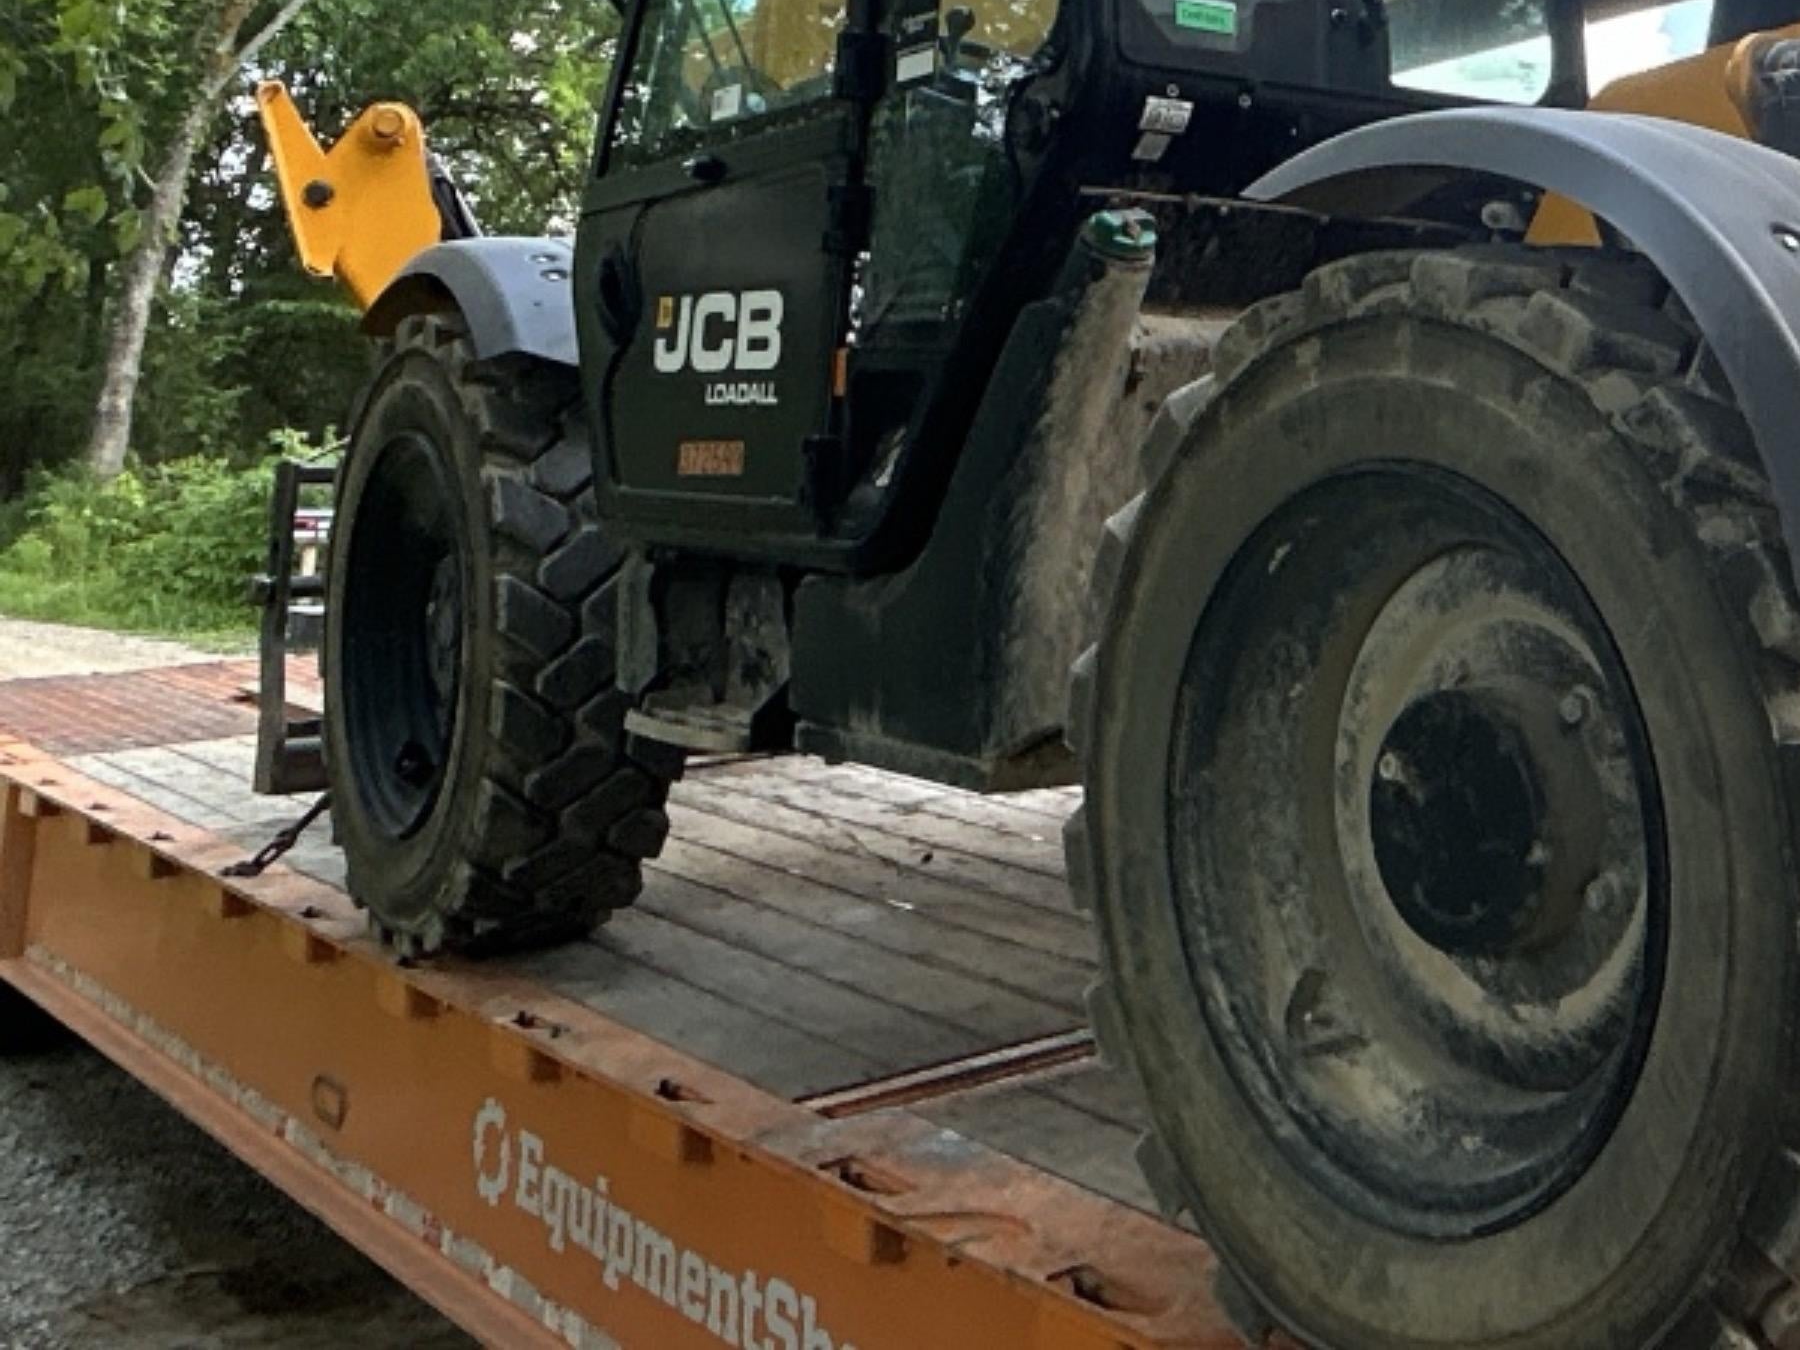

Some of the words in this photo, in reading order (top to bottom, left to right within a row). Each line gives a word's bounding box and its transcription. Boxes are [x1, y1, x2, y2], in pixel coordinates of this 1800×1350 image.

[654, 290, 784, 373] JCB
[705, 382, 778, 406] LOADALL
[516, 1129, 857, 1350] EquipmentSh
